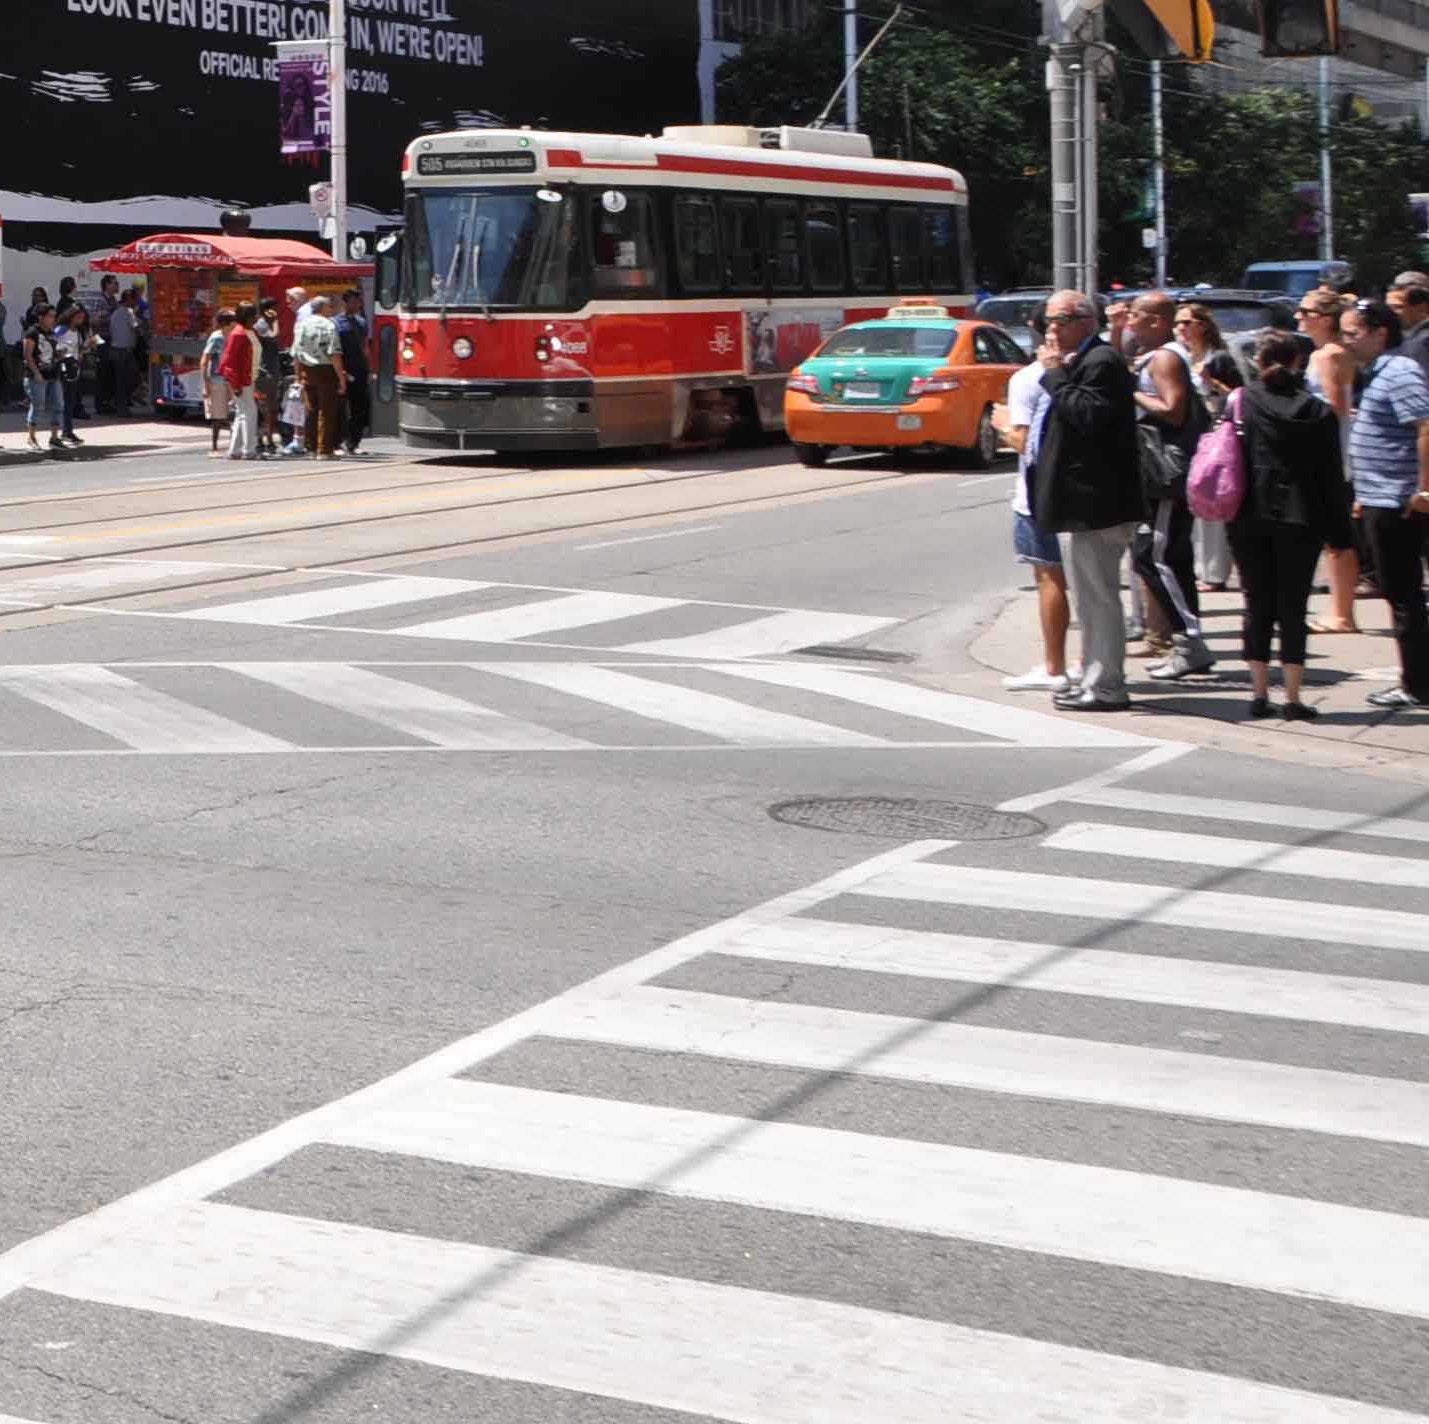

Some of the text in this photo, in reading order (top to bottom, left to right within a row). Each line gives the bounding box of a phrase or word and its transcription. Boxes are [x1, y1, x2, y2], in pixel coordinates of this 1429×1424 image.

[291, 6, 345, 43] COM
[350, 16, 374, 57] IN,
[378, 22, 431, 60] WE'RE
[434, 30, 484, 67] OPEN!
[199, 51, 260, 79] OFFICIAL
[361, 72, 390, 95] 2016
[312, 61, 331, 136] STYLE
